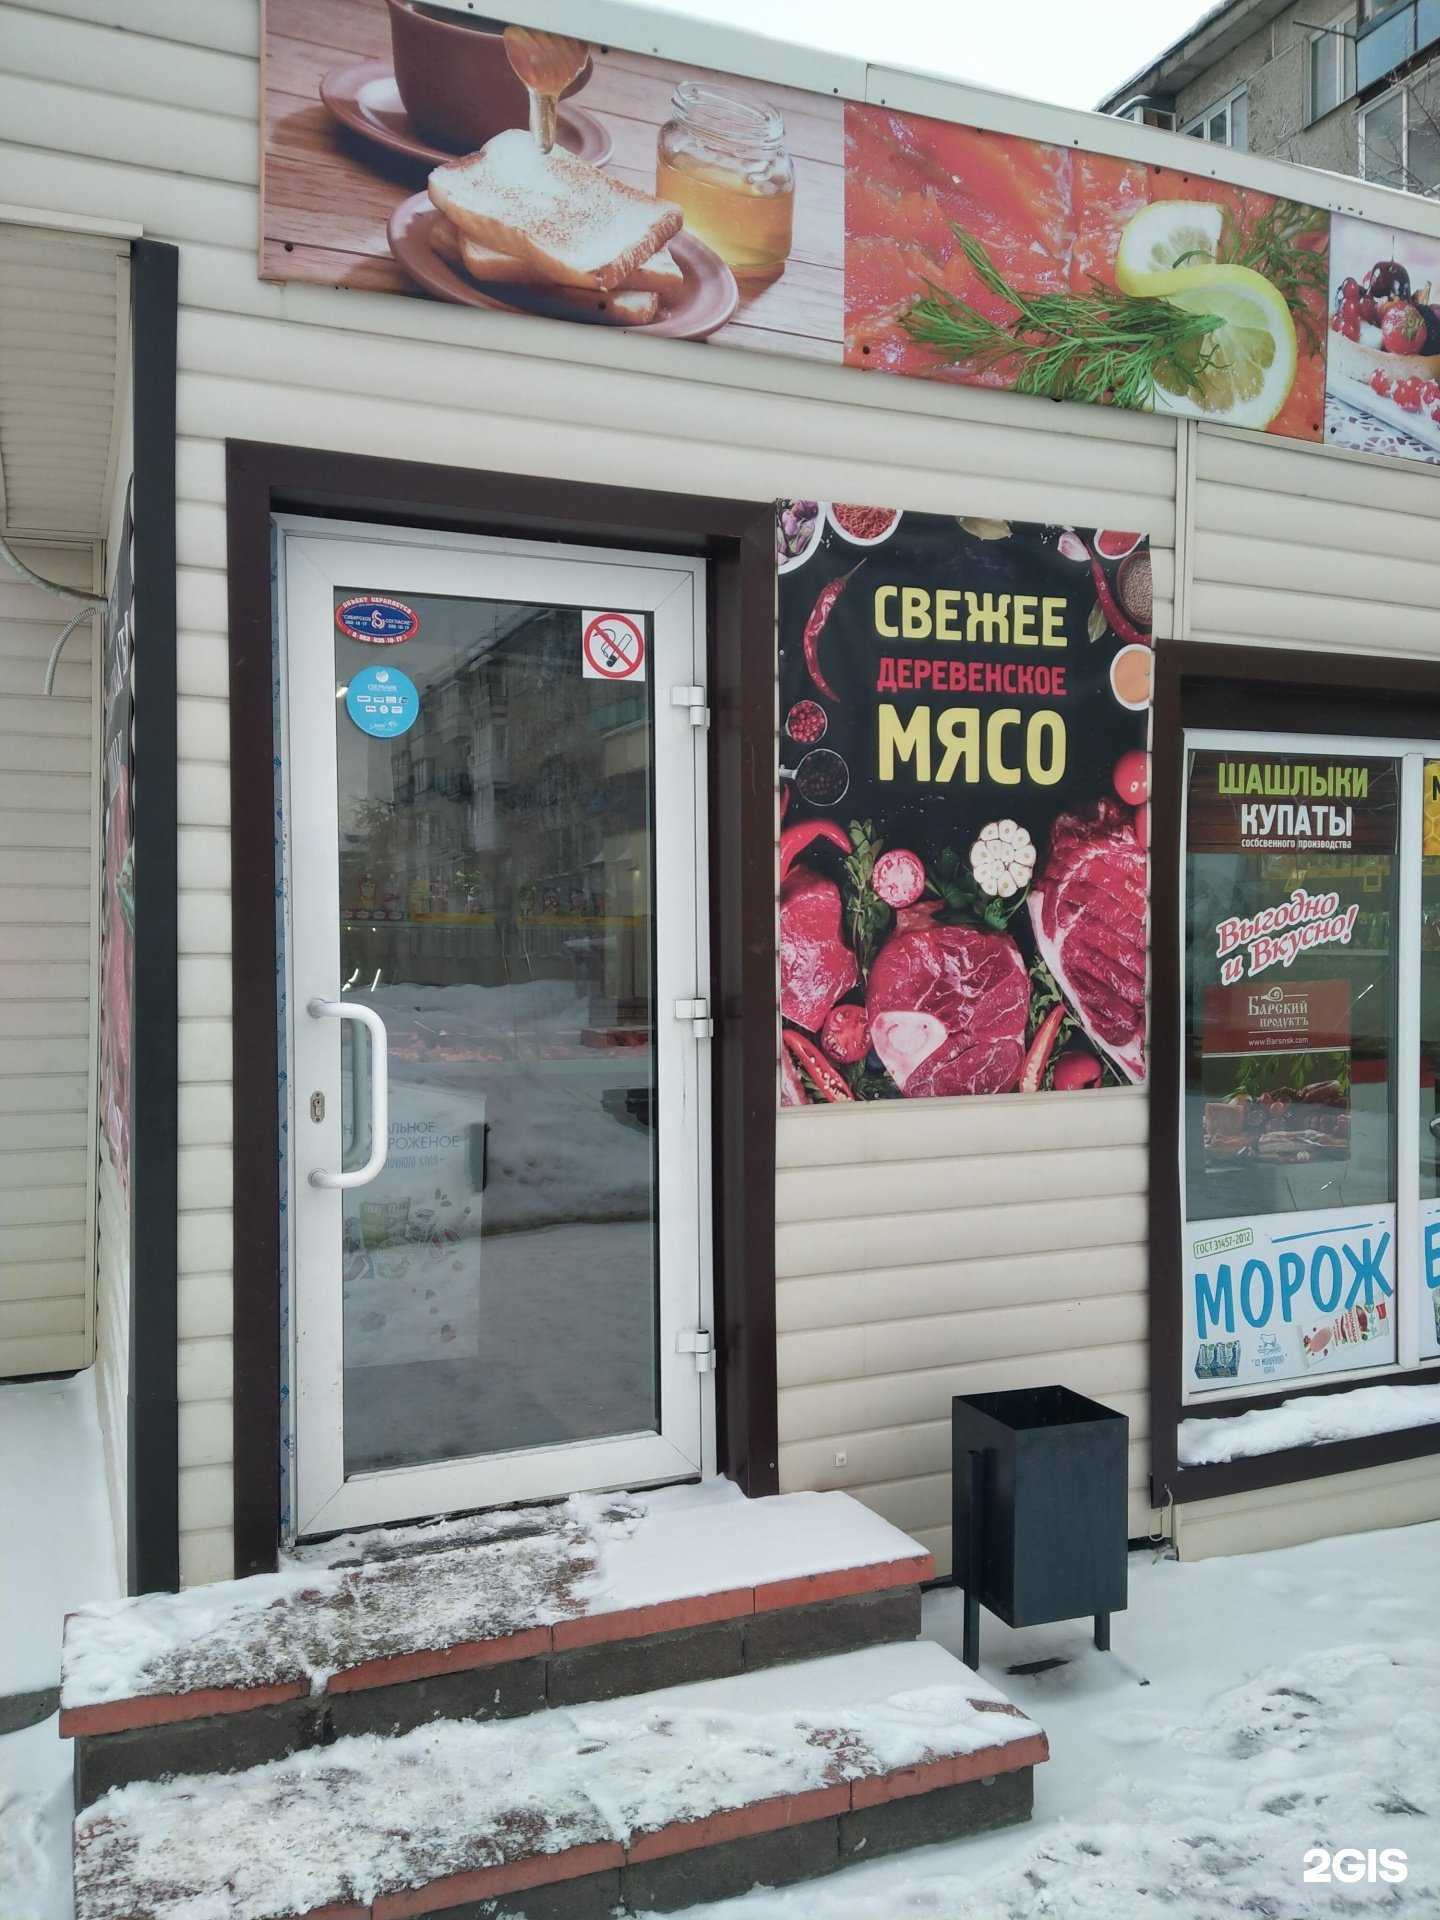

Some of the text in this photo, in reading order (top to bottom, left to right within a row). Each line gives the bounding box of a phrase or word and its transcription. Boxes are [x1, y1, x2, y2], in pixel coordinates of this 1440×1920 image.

[874, 585, 1068, 647] СВЕЖЕЕ
[876, 657, 1067, 696] ДЕРЕВЕНСКОЕ
[878, 703, 1067, 786] МЯСО
[1218, 762, 1368, 798] ШАШЛЫКИ
[1240, 803, 1352, 837] КУПАТЫ
[1298, 839, 1352, 850] производства
[1216, 889, 1340, 957] Выгодно
[1221, 904, 1359, 985] и Вкусно!
[1194, 1231, 1393, 1340] МОРОЖ
